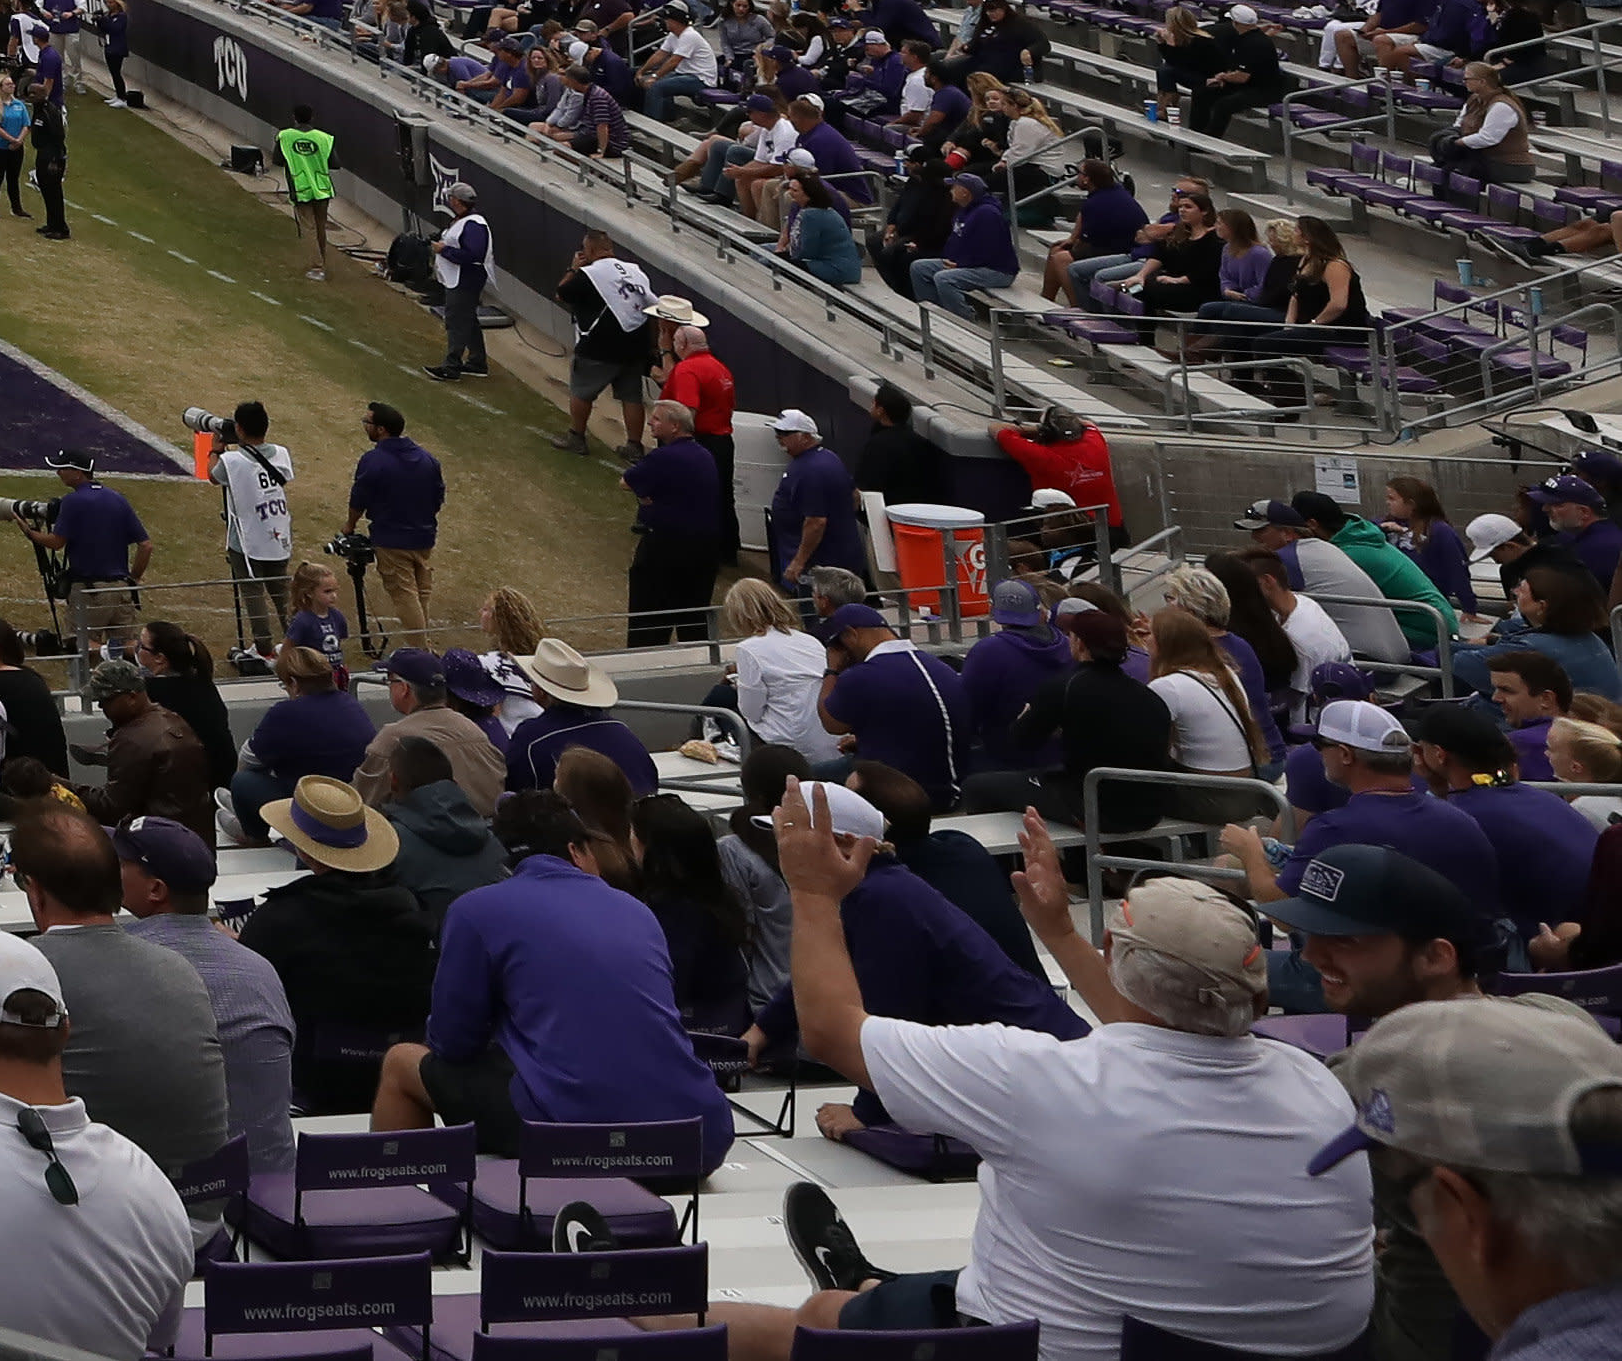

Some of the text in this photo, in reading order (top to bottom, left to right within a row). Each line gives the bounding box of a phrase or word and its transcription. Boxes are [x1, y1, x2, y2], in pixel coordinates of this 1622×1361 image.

[213, 35, 248, 102] TCU
[256, 498, 286, 520] TCU
[328, 1162, 447, 1180] www.frogseats.com
[551, 1153, 674, 1169] www.frogseats.com
[244, 1300, 395, 1323] www.frogseats.com
[523, 1289, 672, 1312] www.frogseats.com
